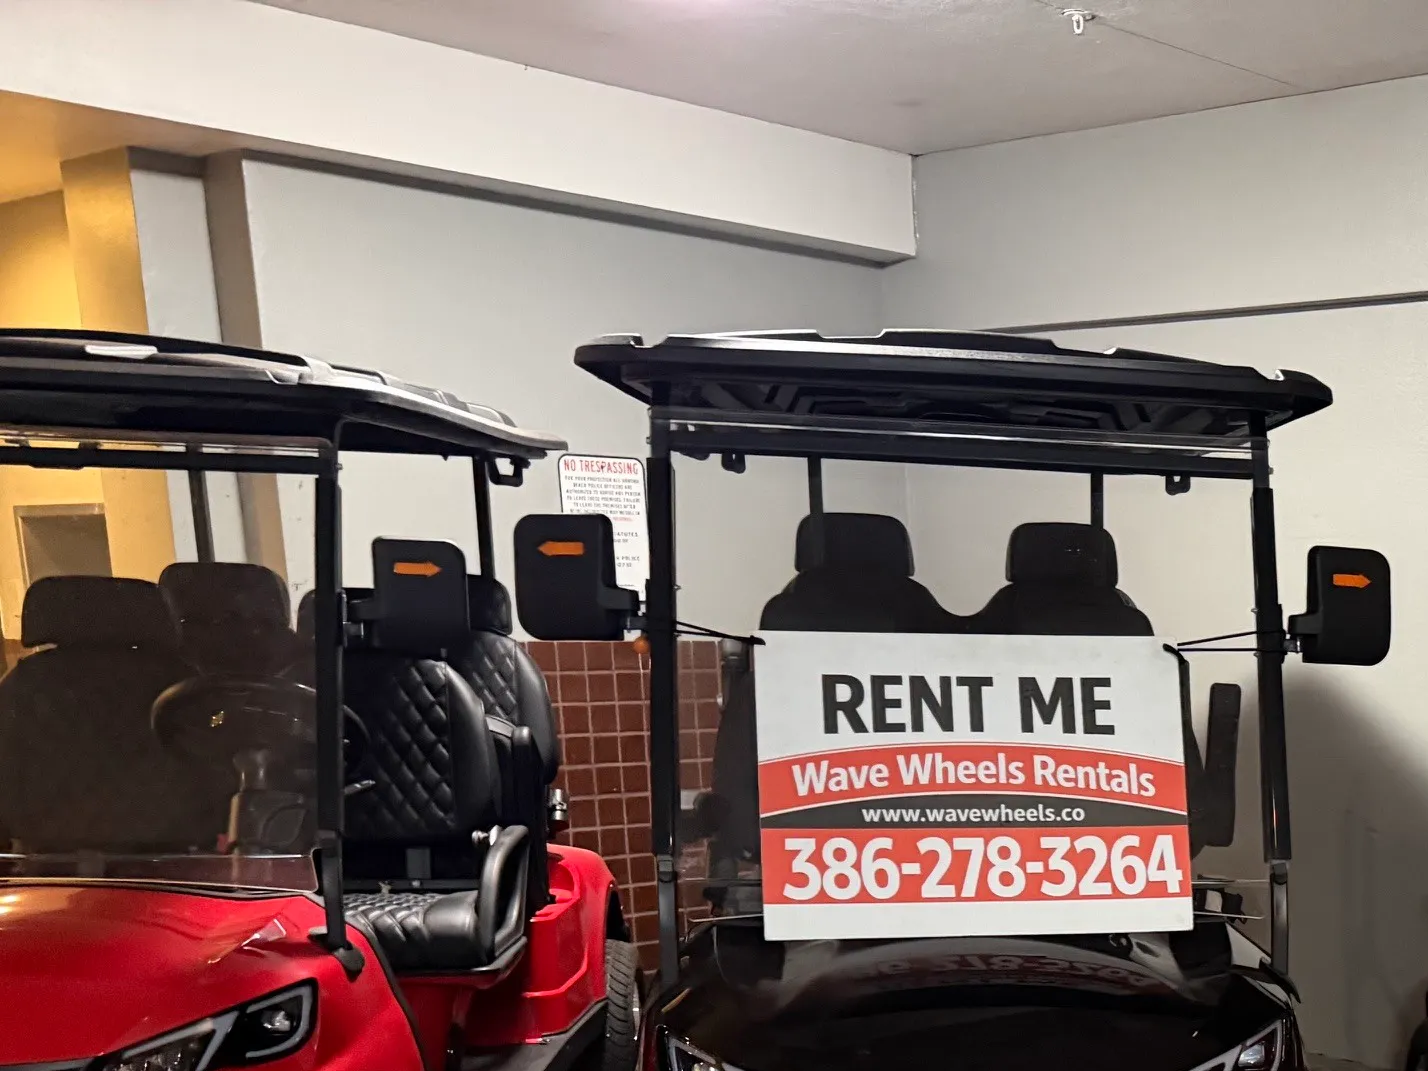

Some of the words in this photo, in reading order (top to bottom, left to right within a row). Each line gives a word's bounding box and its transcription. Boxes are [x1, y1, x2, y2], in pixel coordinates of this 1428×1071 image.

[564, 460, 576, 472] NO
[580, 460, 638, 474] TRESPASSING
[822, 674, 993, 734] RENT
[1018, 677, 1116, 735] ME
[792, 761, 889, 796] Wave
[897, 753, 1024, 786] Wheels
[1033, 755, 1156, 797] Rentals
[862, 804, 1086, 823] www.wavewheels.co
[783, 834, 1183, 900] 386-278-3264
